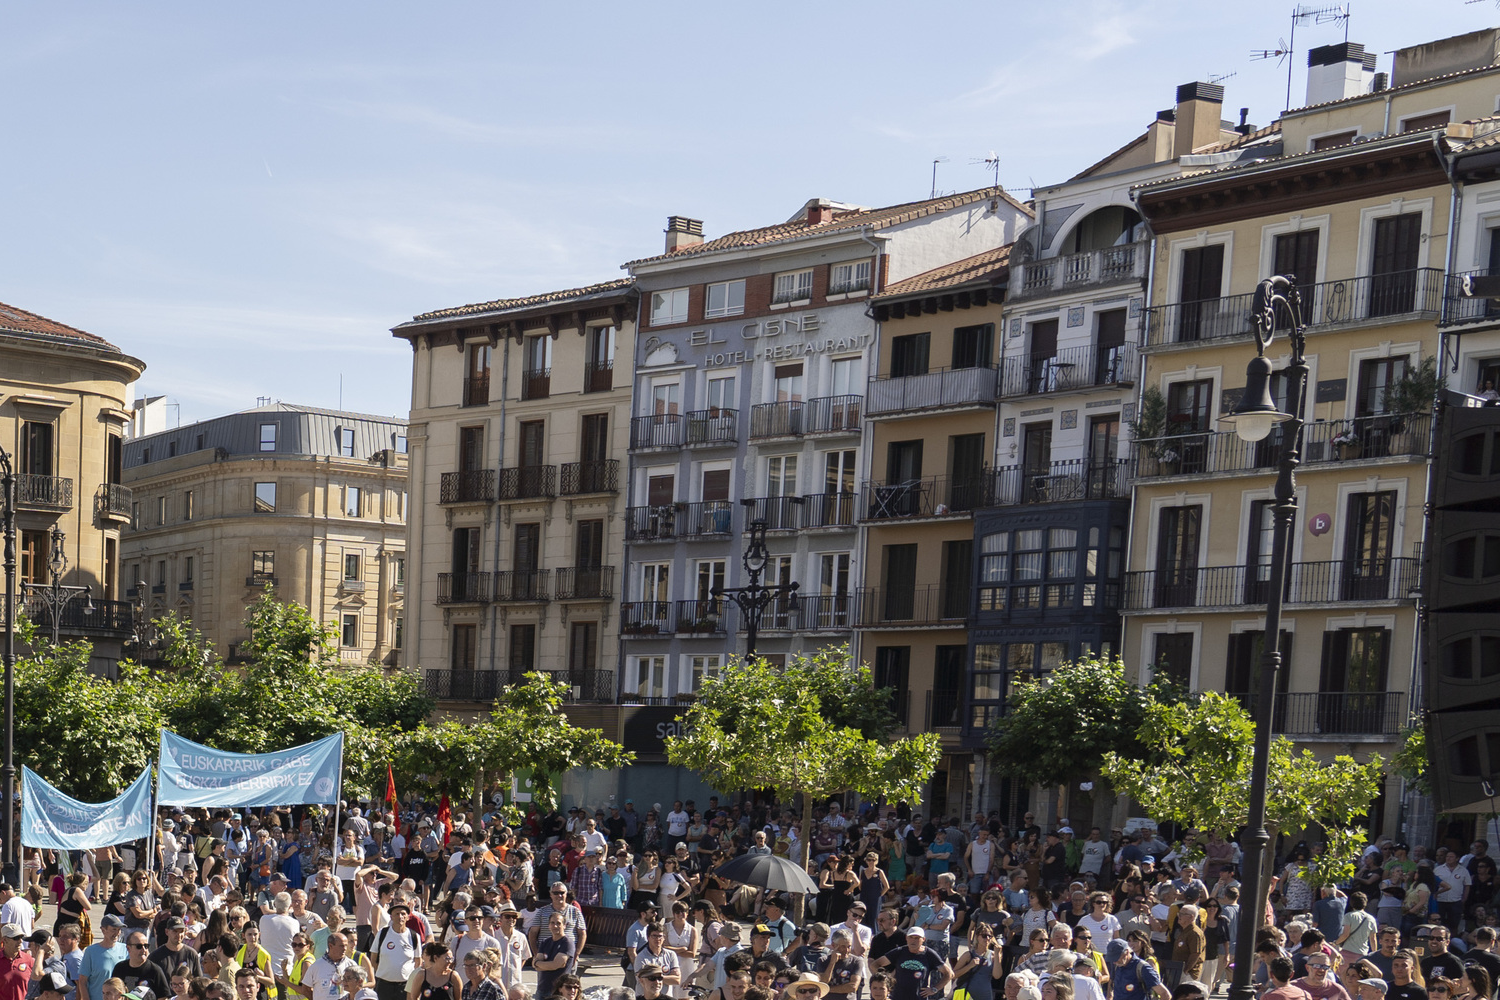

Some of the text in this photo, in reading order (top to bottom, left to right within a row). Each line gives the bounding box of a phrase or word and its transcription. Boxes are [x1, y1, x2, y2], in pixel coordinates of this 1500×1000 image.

[690, 314, 820, 347] EL CISNE
[704, 350, 754, 367] HOTEL
[181, 753, 311, 772] EUSKARARIK GABE
[175, 771, 316, 791] EUSKAL HERRIRIK EZ
[88, 811, 143, 836] BATEAN
